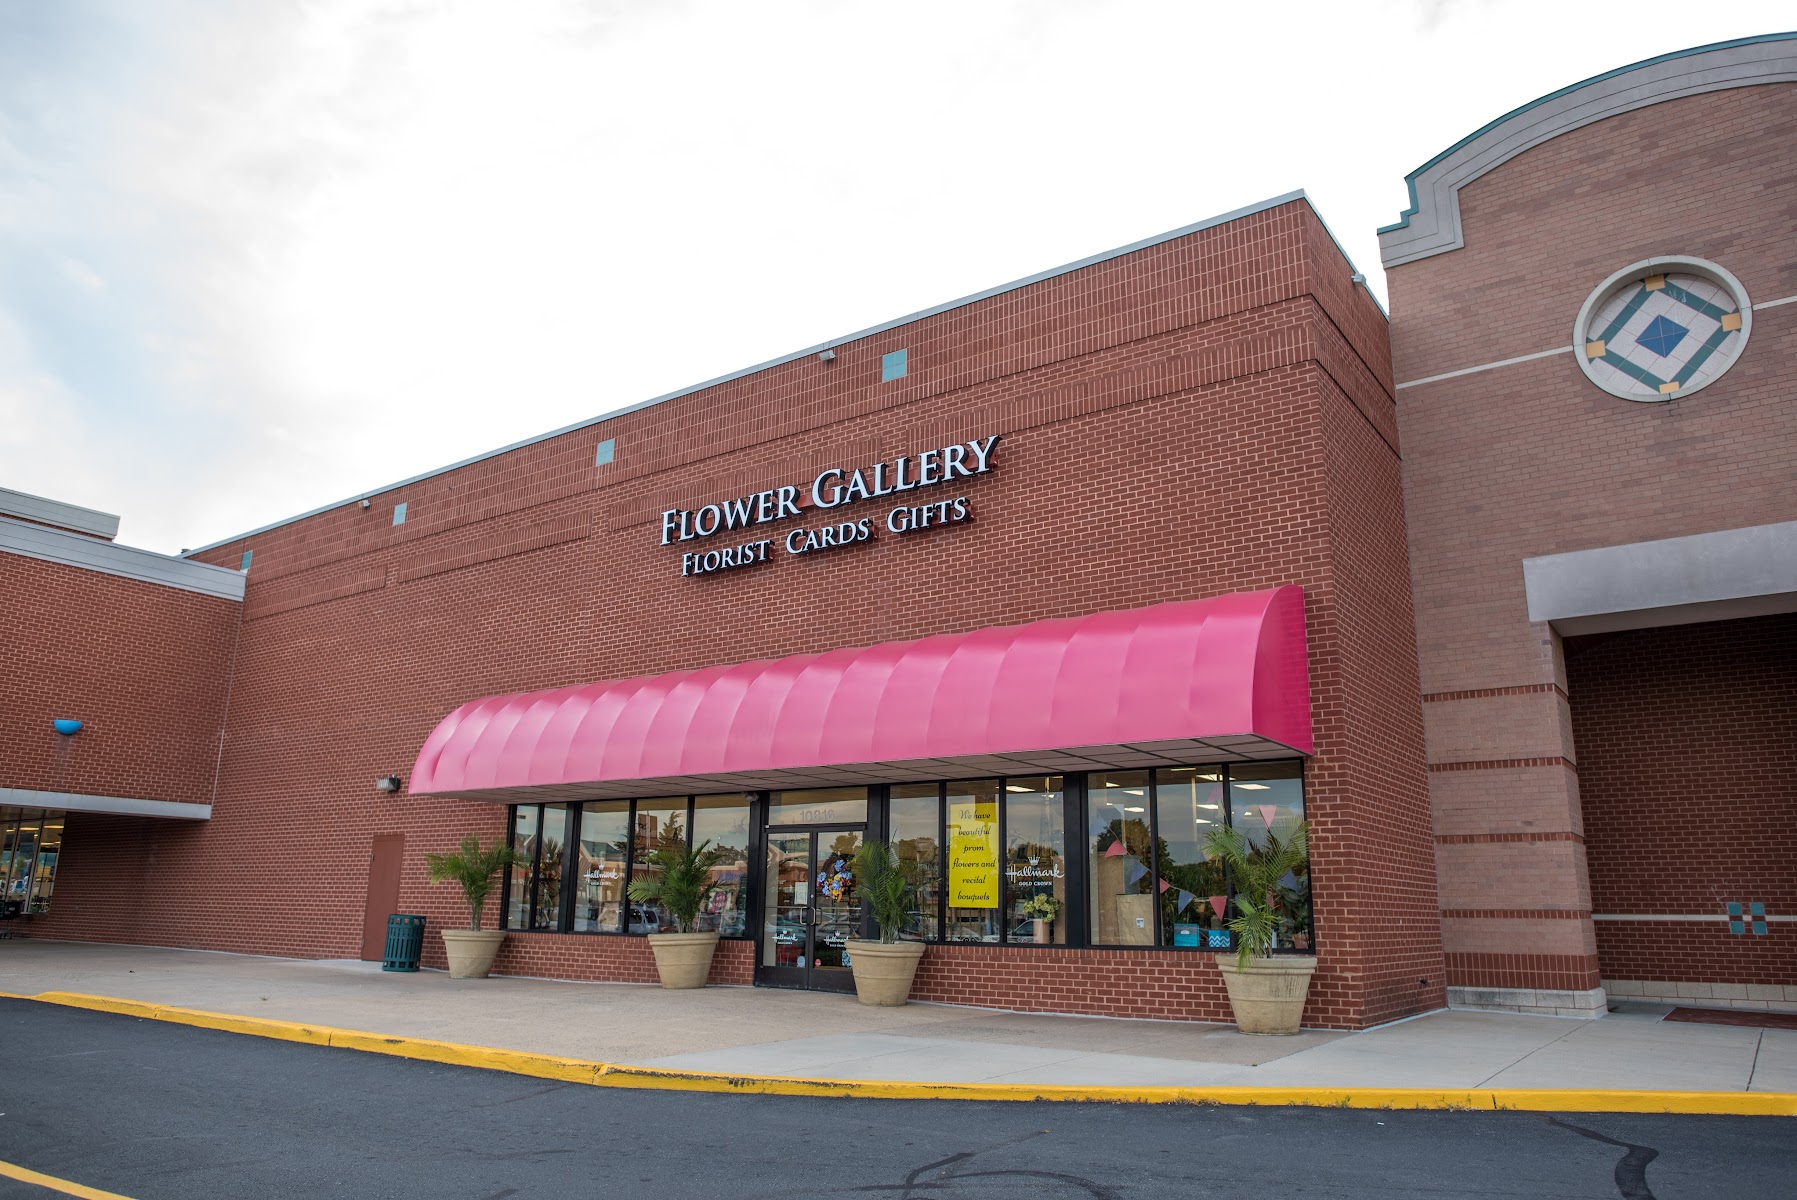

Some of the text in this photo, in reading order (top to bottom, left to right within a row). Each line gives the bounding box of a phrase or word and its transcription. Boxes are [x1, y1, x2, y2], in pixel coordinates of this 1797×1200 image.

[660, 434, 1003, 546] FLOWER GALLERY
[681, 496, 971, 577] FLORIST CARDS GIFTS
[959, 809, 991, 819] We have
[958, 825, 991, 837] beautiful
[963, 844, 984, 854] prom
[952, 857, 997, 870] flowers and
[583, 867, 619, 883] Hallmark
[962, 874, 987, 884] recital
[1004, 863, 1065, 884] Hallmark
[957, 890, 990, 903] bouquets
